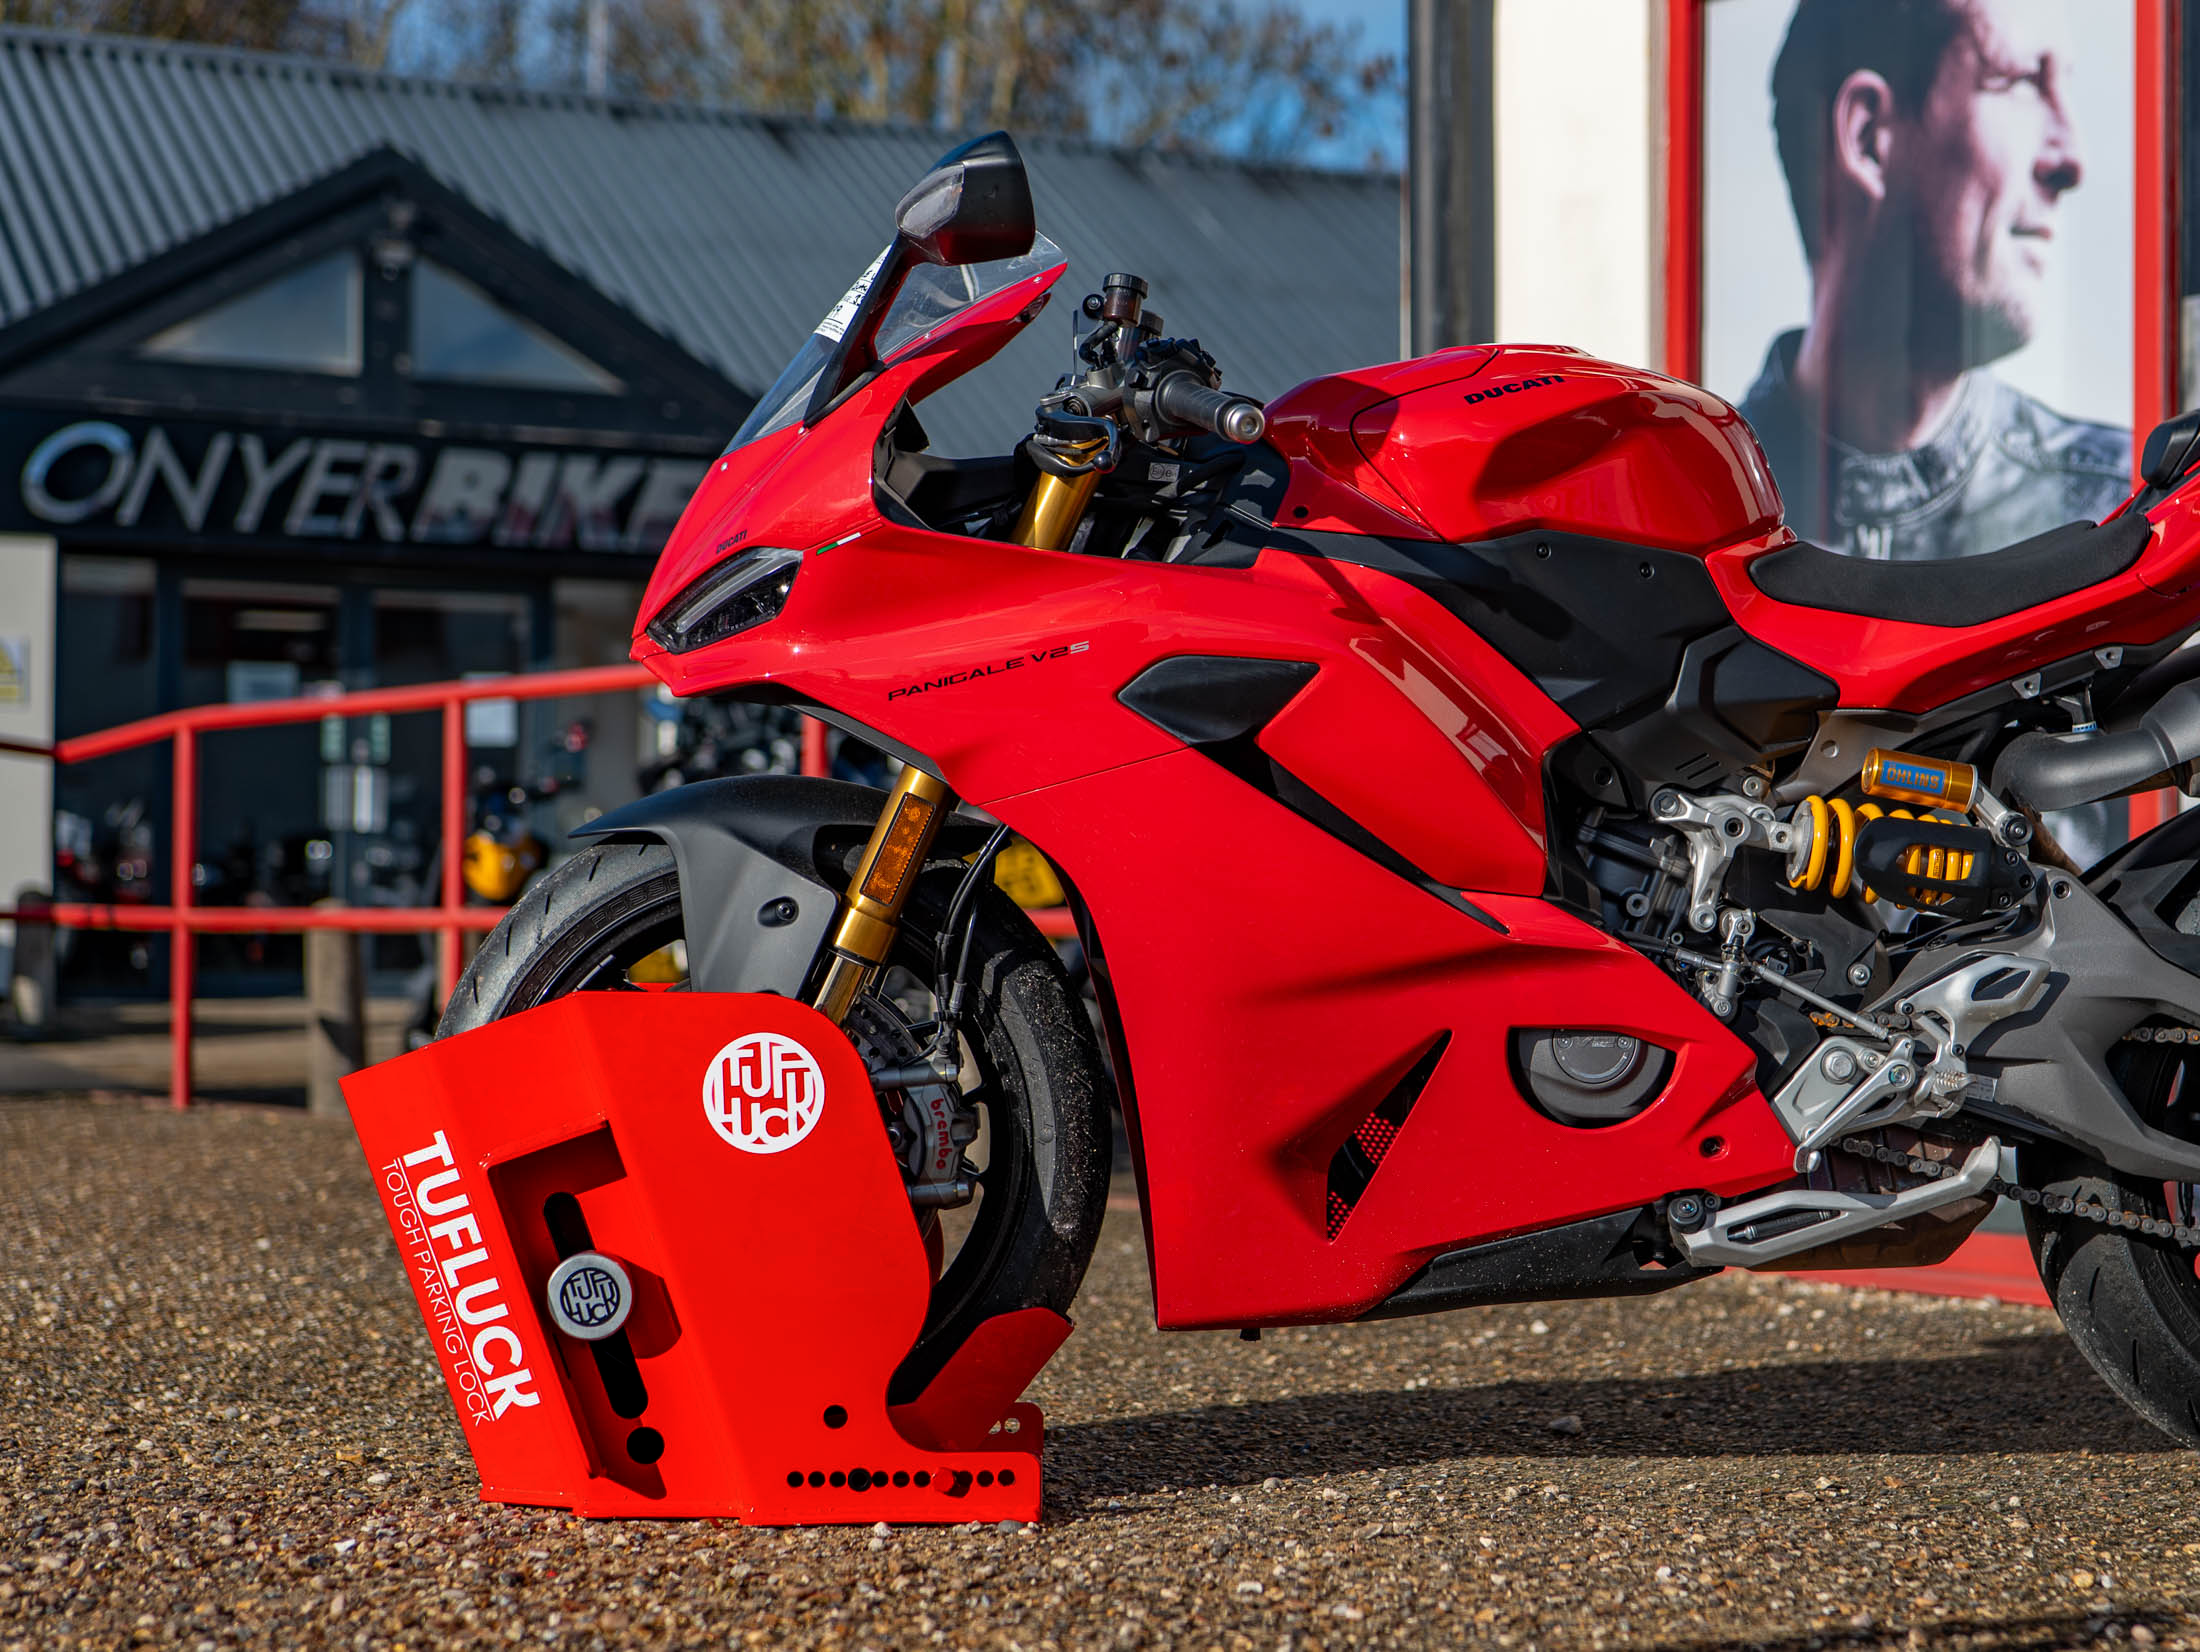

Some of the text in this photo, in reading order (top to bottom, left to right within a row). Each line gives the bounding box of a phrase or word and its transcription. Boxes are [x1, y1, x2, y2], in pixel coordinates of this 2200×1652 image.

[1463, 375, 1566, 405] DUCATI
[716, 529, 747, 555] DUCATI
[888, 656, 1024, 701] PANIGALE
[1887, 762, 1939, 790] ÖHLINS
[930, 1098, 953, 1170] brembo
[382, 1158, 490, 1428] TOUGH PARKING LOCK
[403, 1129, 540, 1420] TUFLUCK
